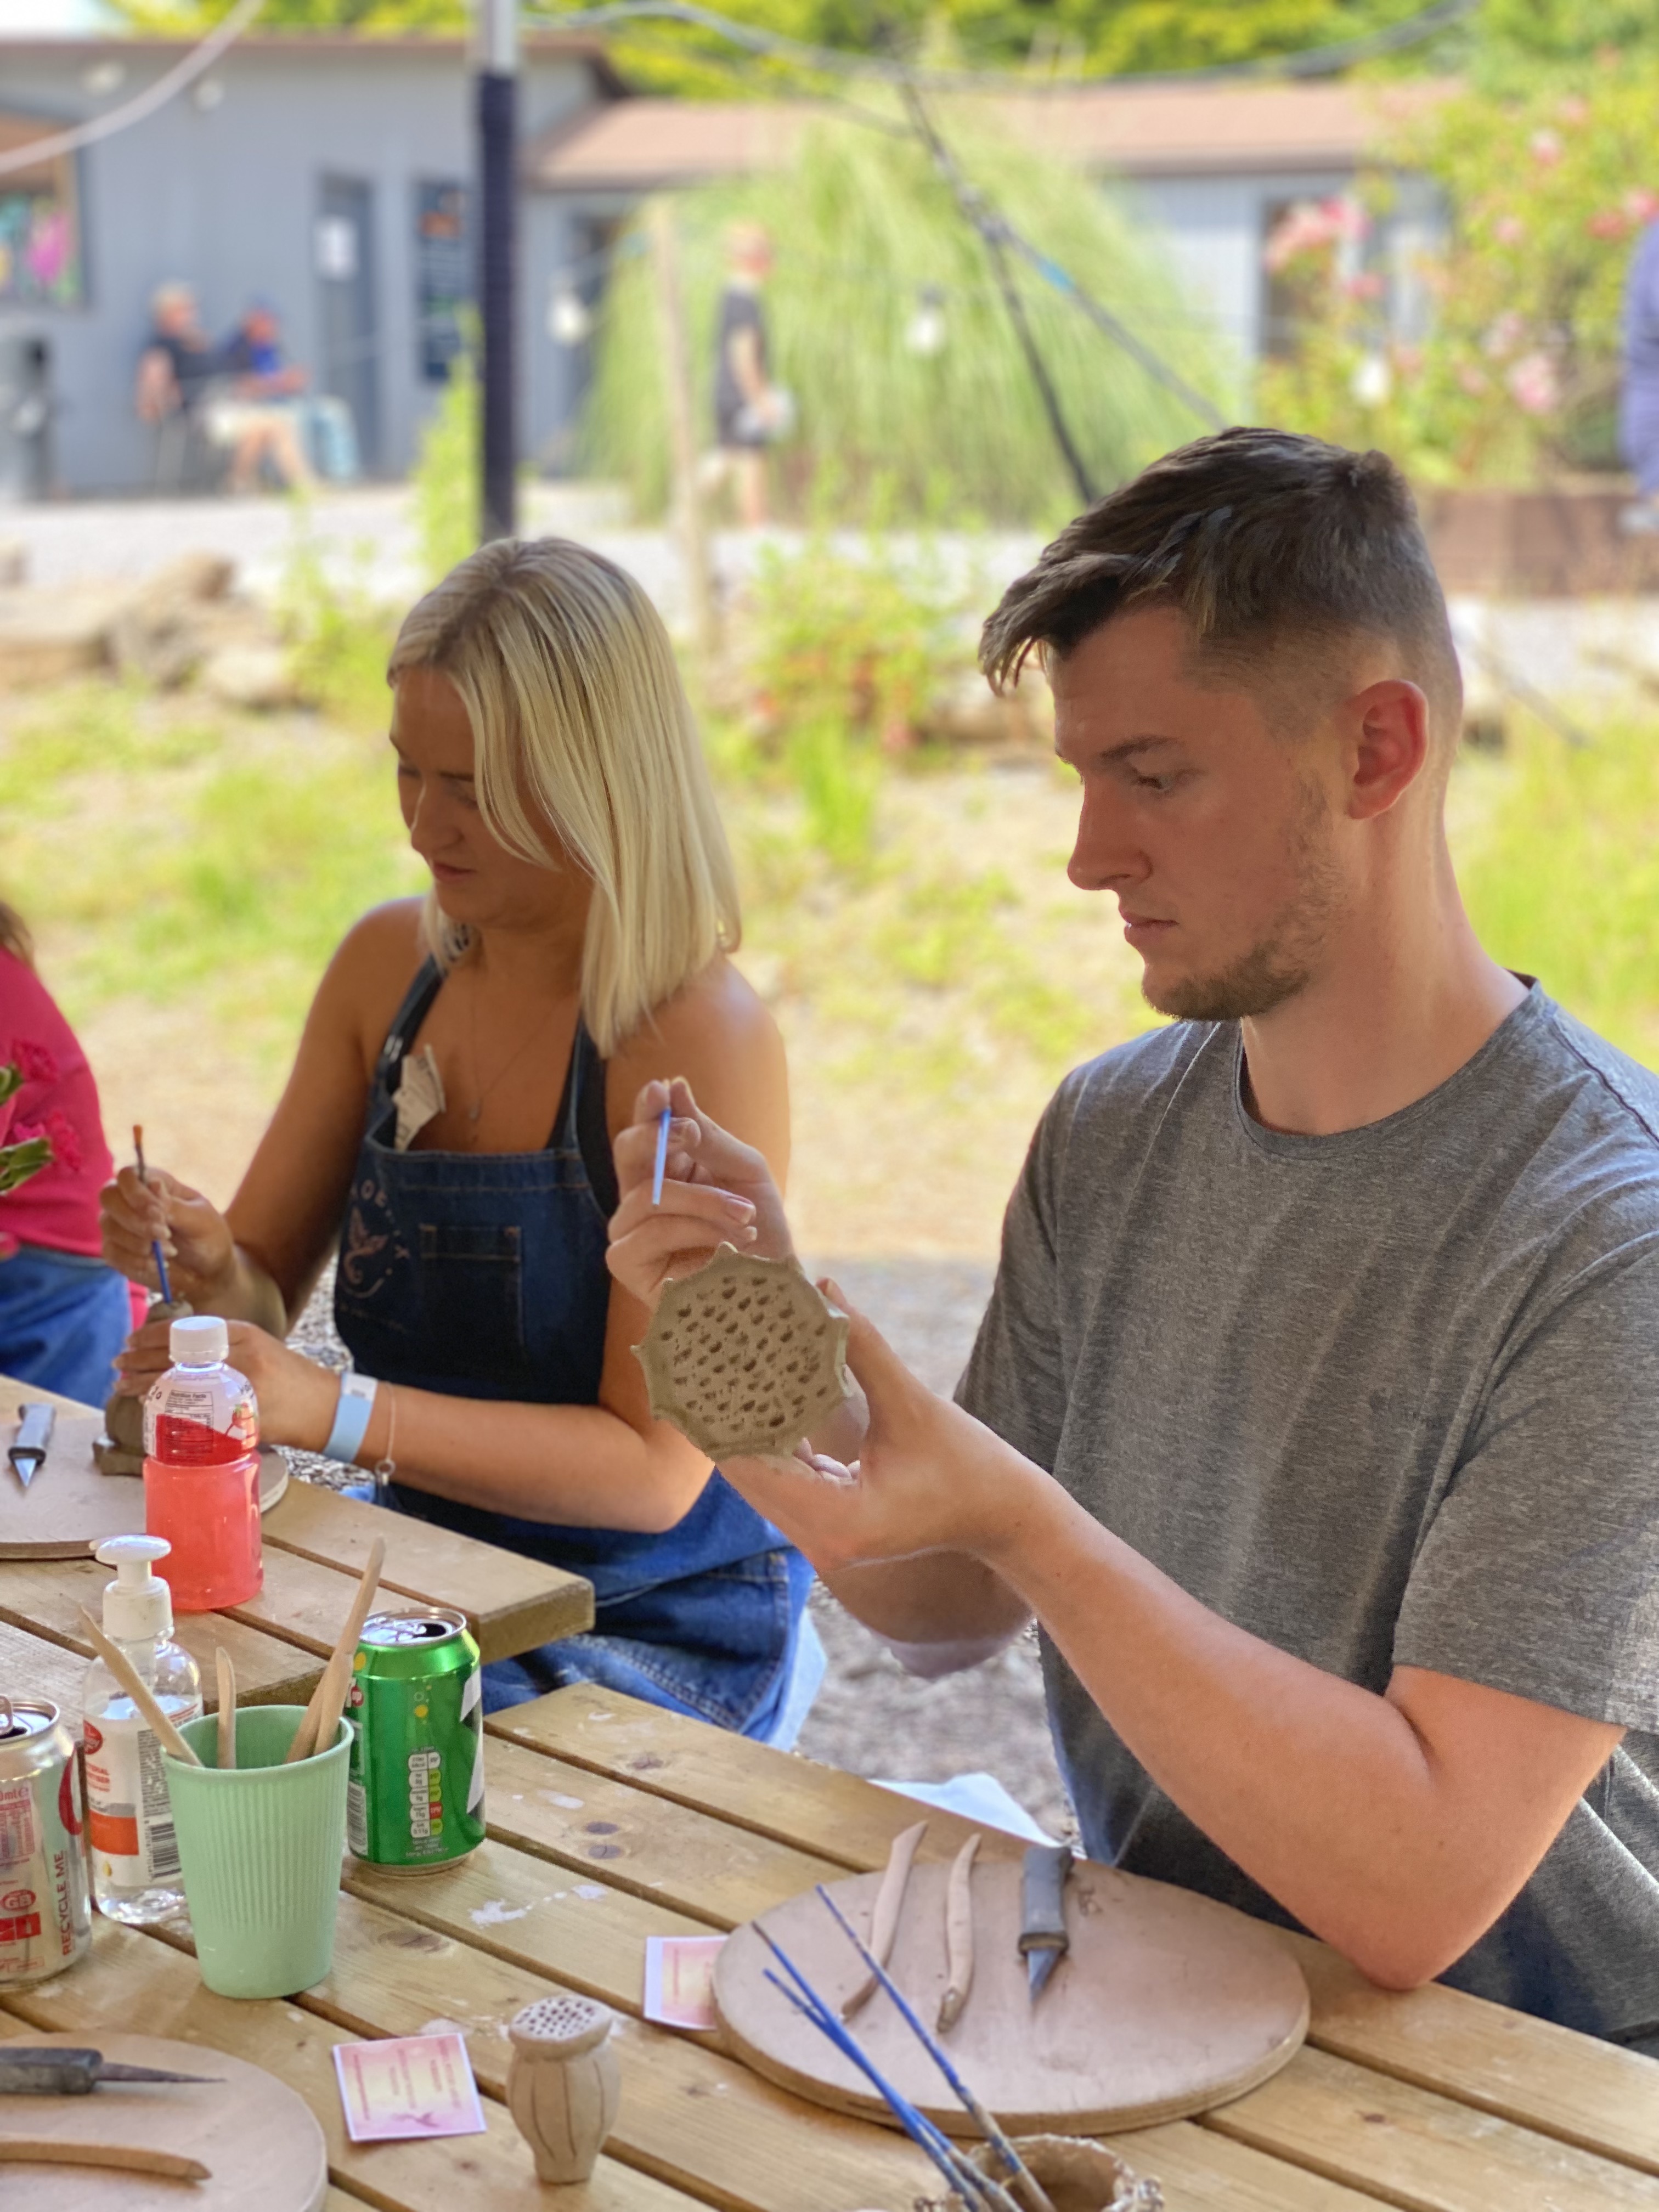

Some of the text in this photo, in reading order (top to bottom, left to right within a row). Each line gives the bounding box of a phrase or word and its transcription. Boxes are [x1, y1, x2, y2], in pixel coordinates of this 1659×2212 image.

[352, 1691, 362, 1702] up
[5, 1892, 32, 1908] GB
[54, 1849, 72, 1956] RECYCLE ME
